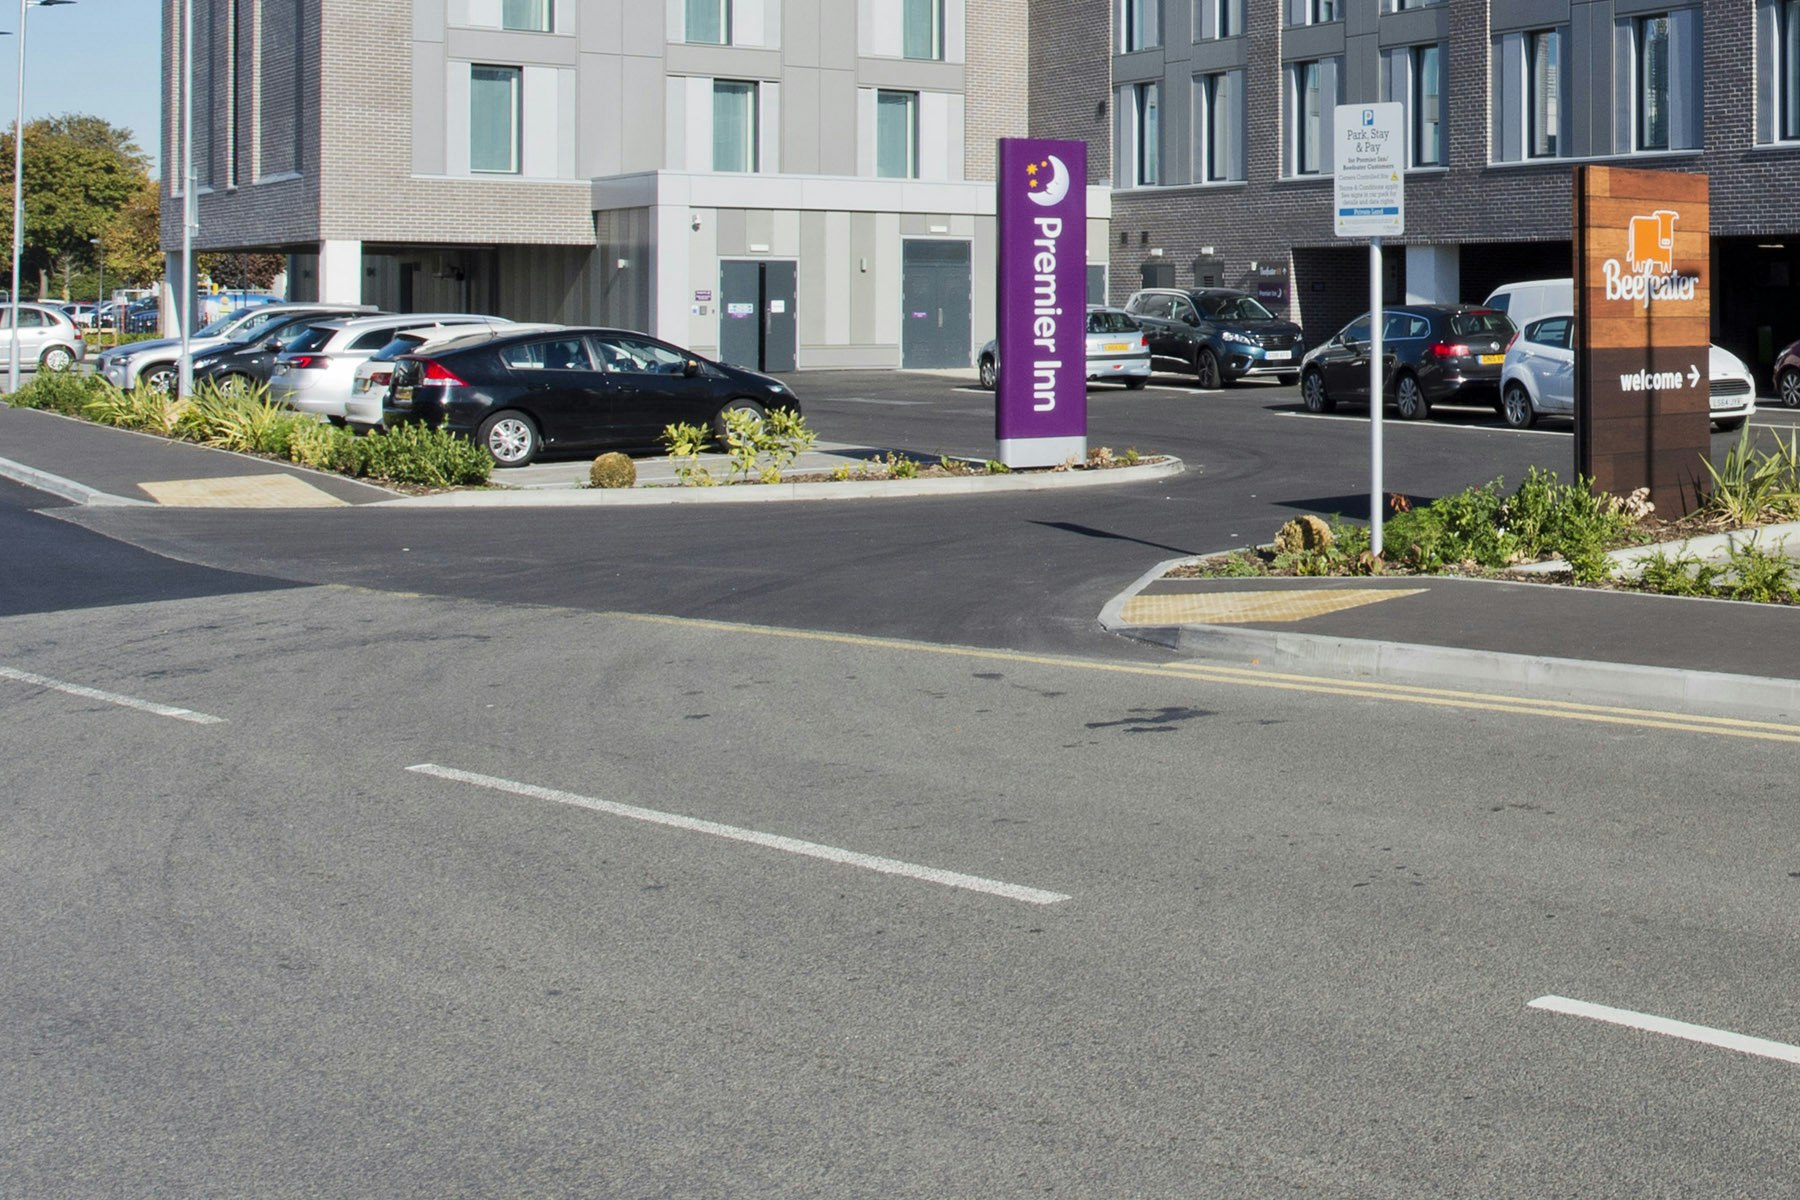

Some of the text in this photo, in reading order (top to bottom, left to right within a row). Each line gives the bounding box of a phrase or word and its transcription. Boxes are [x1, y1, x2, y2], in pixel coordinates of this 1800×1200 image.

[1347, 128, 1390, 141] Park, Stay
[1356, 141, 1381, 155] & Pay
[1602, 258, 1699, 309] Beefeater
[1032, 216, 1063, 412] Premier Inn
[1620, 369, 1684, 392] welcome
